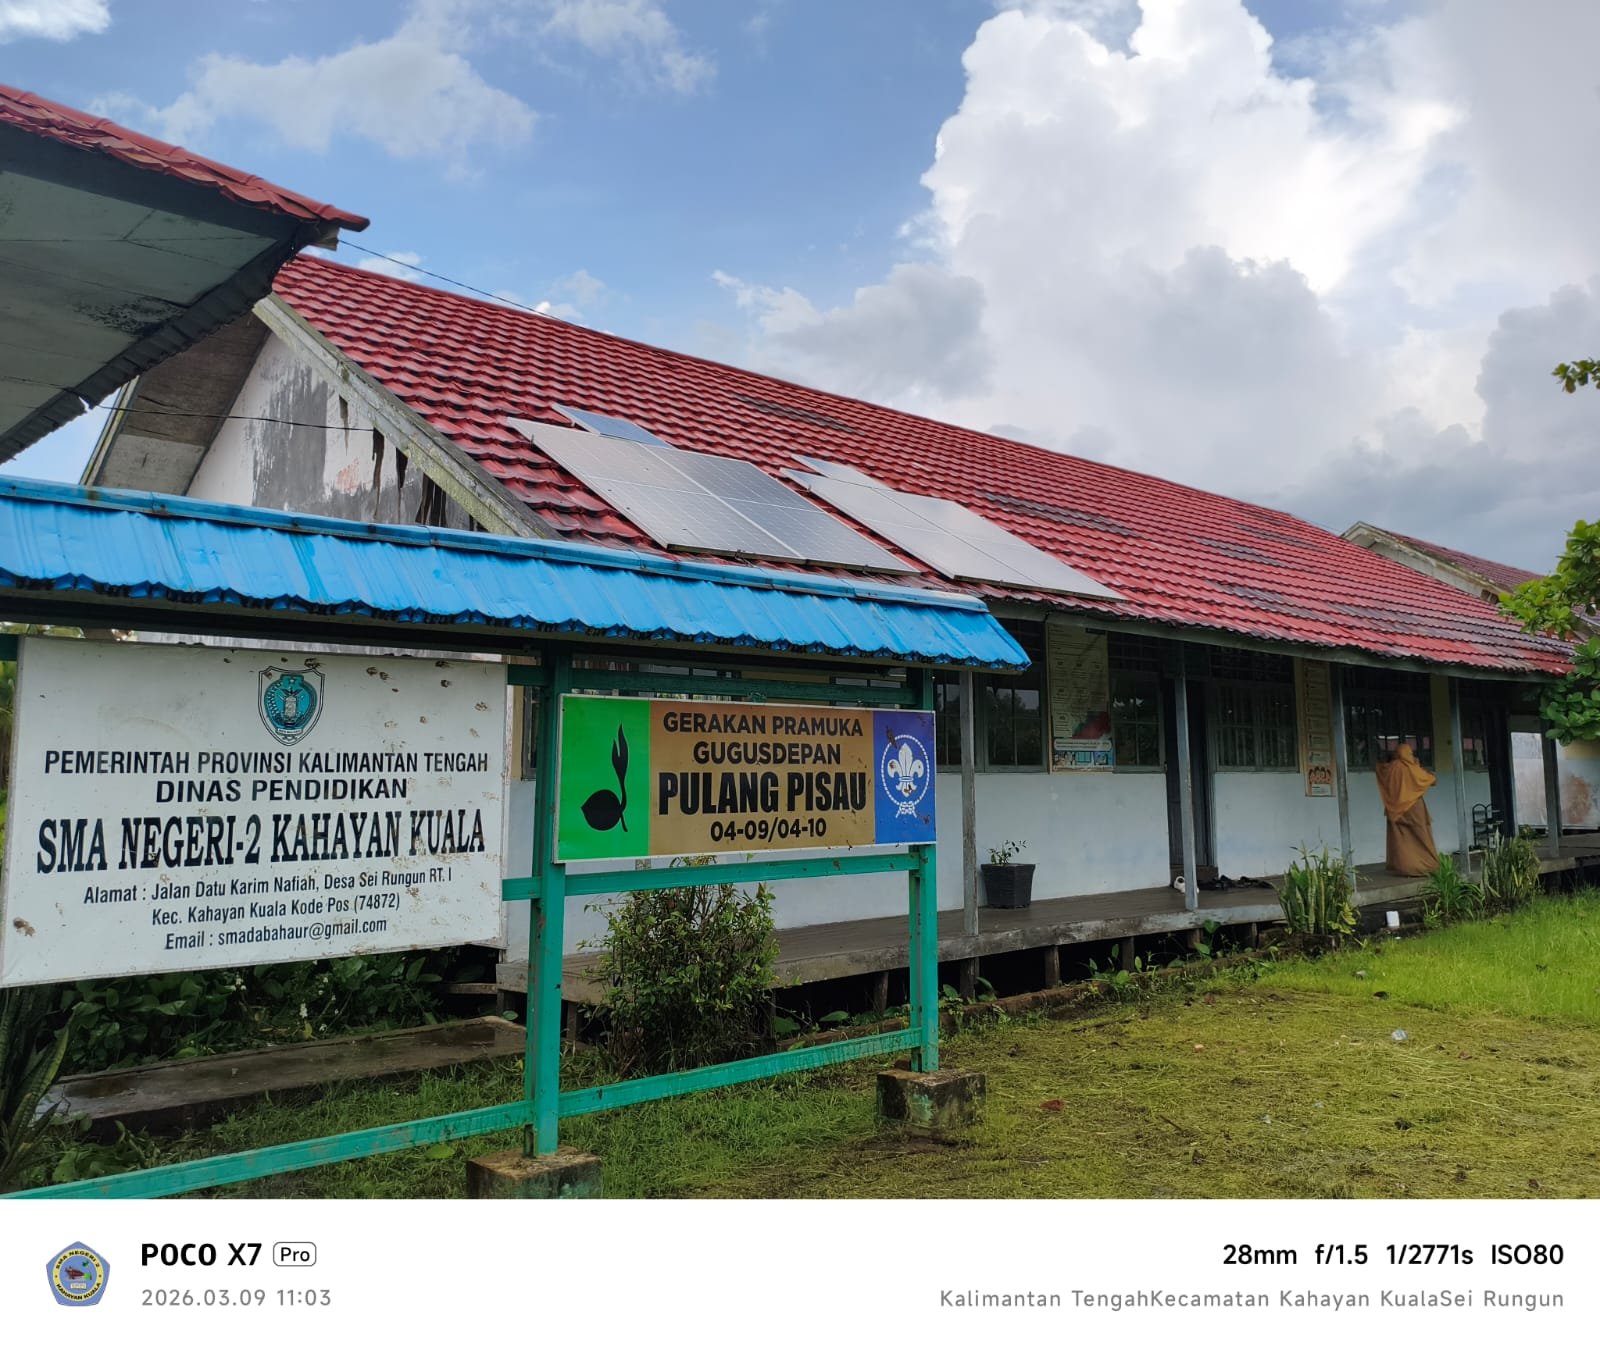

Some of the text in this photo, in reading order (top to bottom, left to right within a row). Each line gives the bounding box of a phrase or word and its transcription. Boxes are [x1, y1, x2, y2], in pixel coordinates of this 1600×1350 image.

[663, 712, 863, 736] GERAKAN PRAMUKA
[45, 750, 487, 774] PEMERINTAH PROVINSI KALIMANTAN TENGAH
[694, 742, 840, 765] GUGUSDEPAN
[156, 778, 407, 802] DINAS PENDIDIKAN
[659, 772, 866, 815] PULANG PISAU
[37, 809, 485, 873] SMA NEGERI-2 KAHAYAN KUALA
[711, 817, 826, 842] 04-09/04-10
[84, 886, 137, 904] Alamat
[151, 883, 190, 901] Jalan
[196, 881, 225, 897] Datu
[230, 877, 268, 895] Karim
[274, 875, 319, 894] Nafiah,
[324, 873, 355, 890] Desa
[360, 871, 377, 888] Sei
[382, 869, 426, 890] Rungun
[429, 869, 445, 882] RT.
[152, 895, 400, 925] Kec. Kahayan Kuala Kode Pos (74872)
[165, 932, 204, 950] Email
[217, 918, 387, 946] smadabahaur@gmail.com
